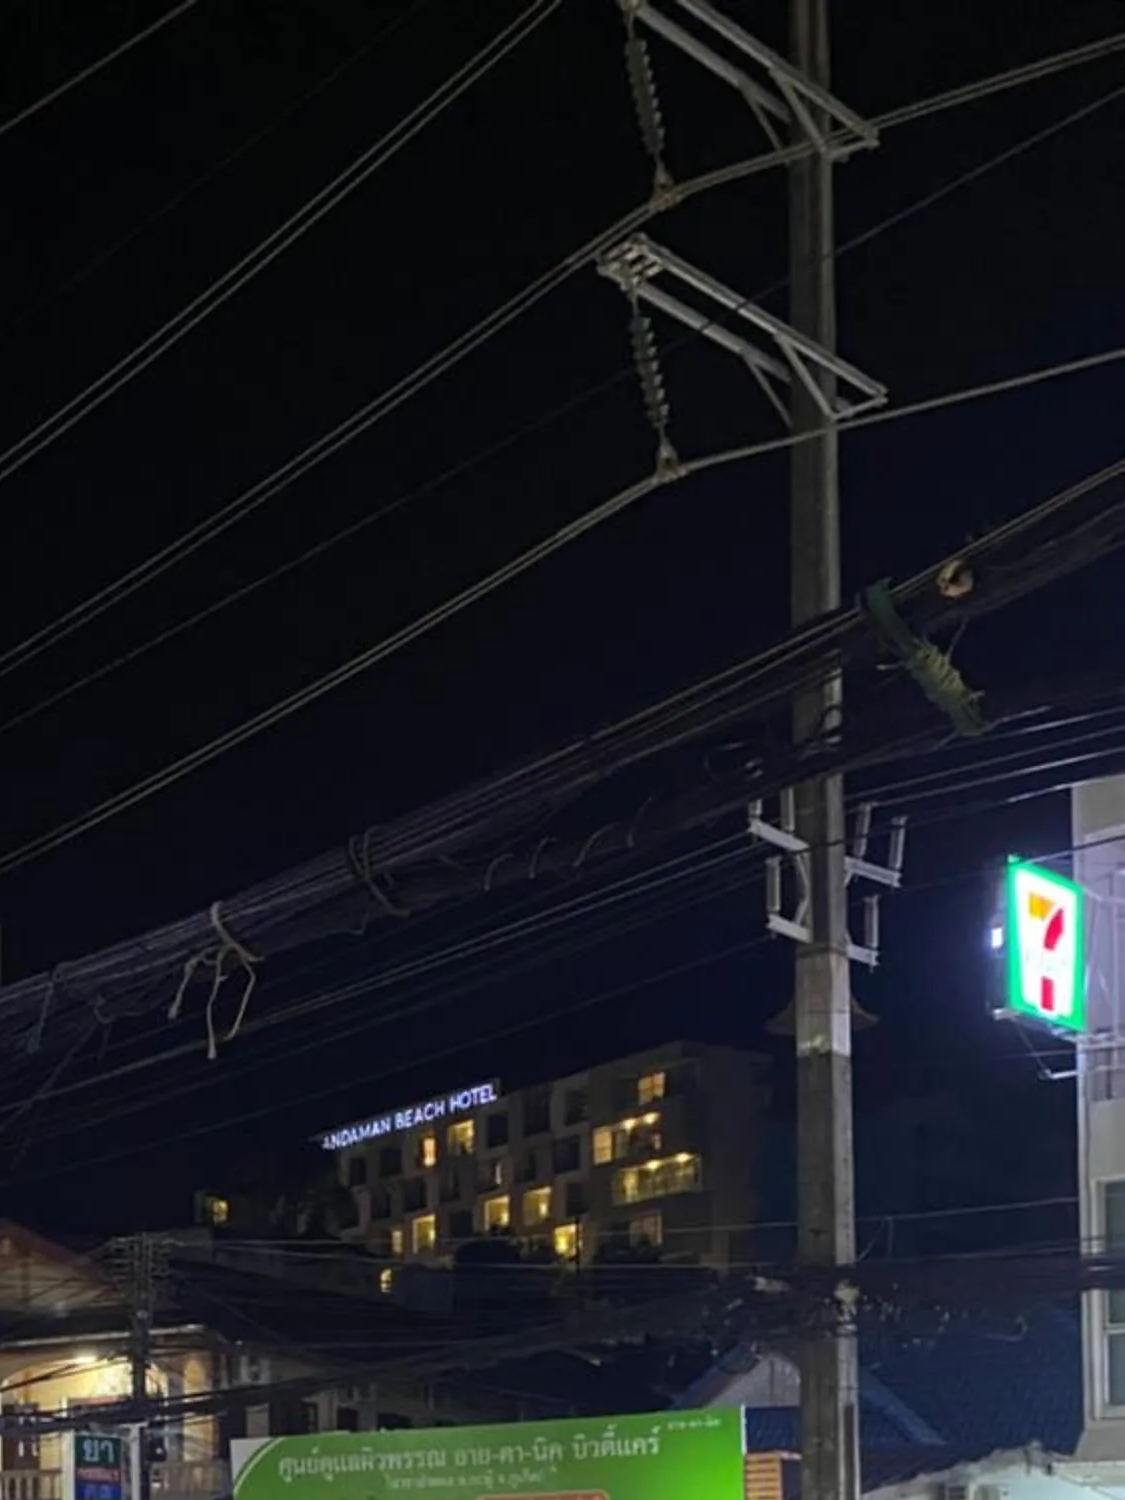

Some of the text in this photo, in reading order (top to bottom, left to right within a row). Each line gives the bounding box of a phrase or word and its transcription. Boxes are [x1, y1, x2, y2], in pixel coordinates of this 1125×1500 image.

[322, 1083, 498, 1150] ANDAMAN BEACH HOTEL
